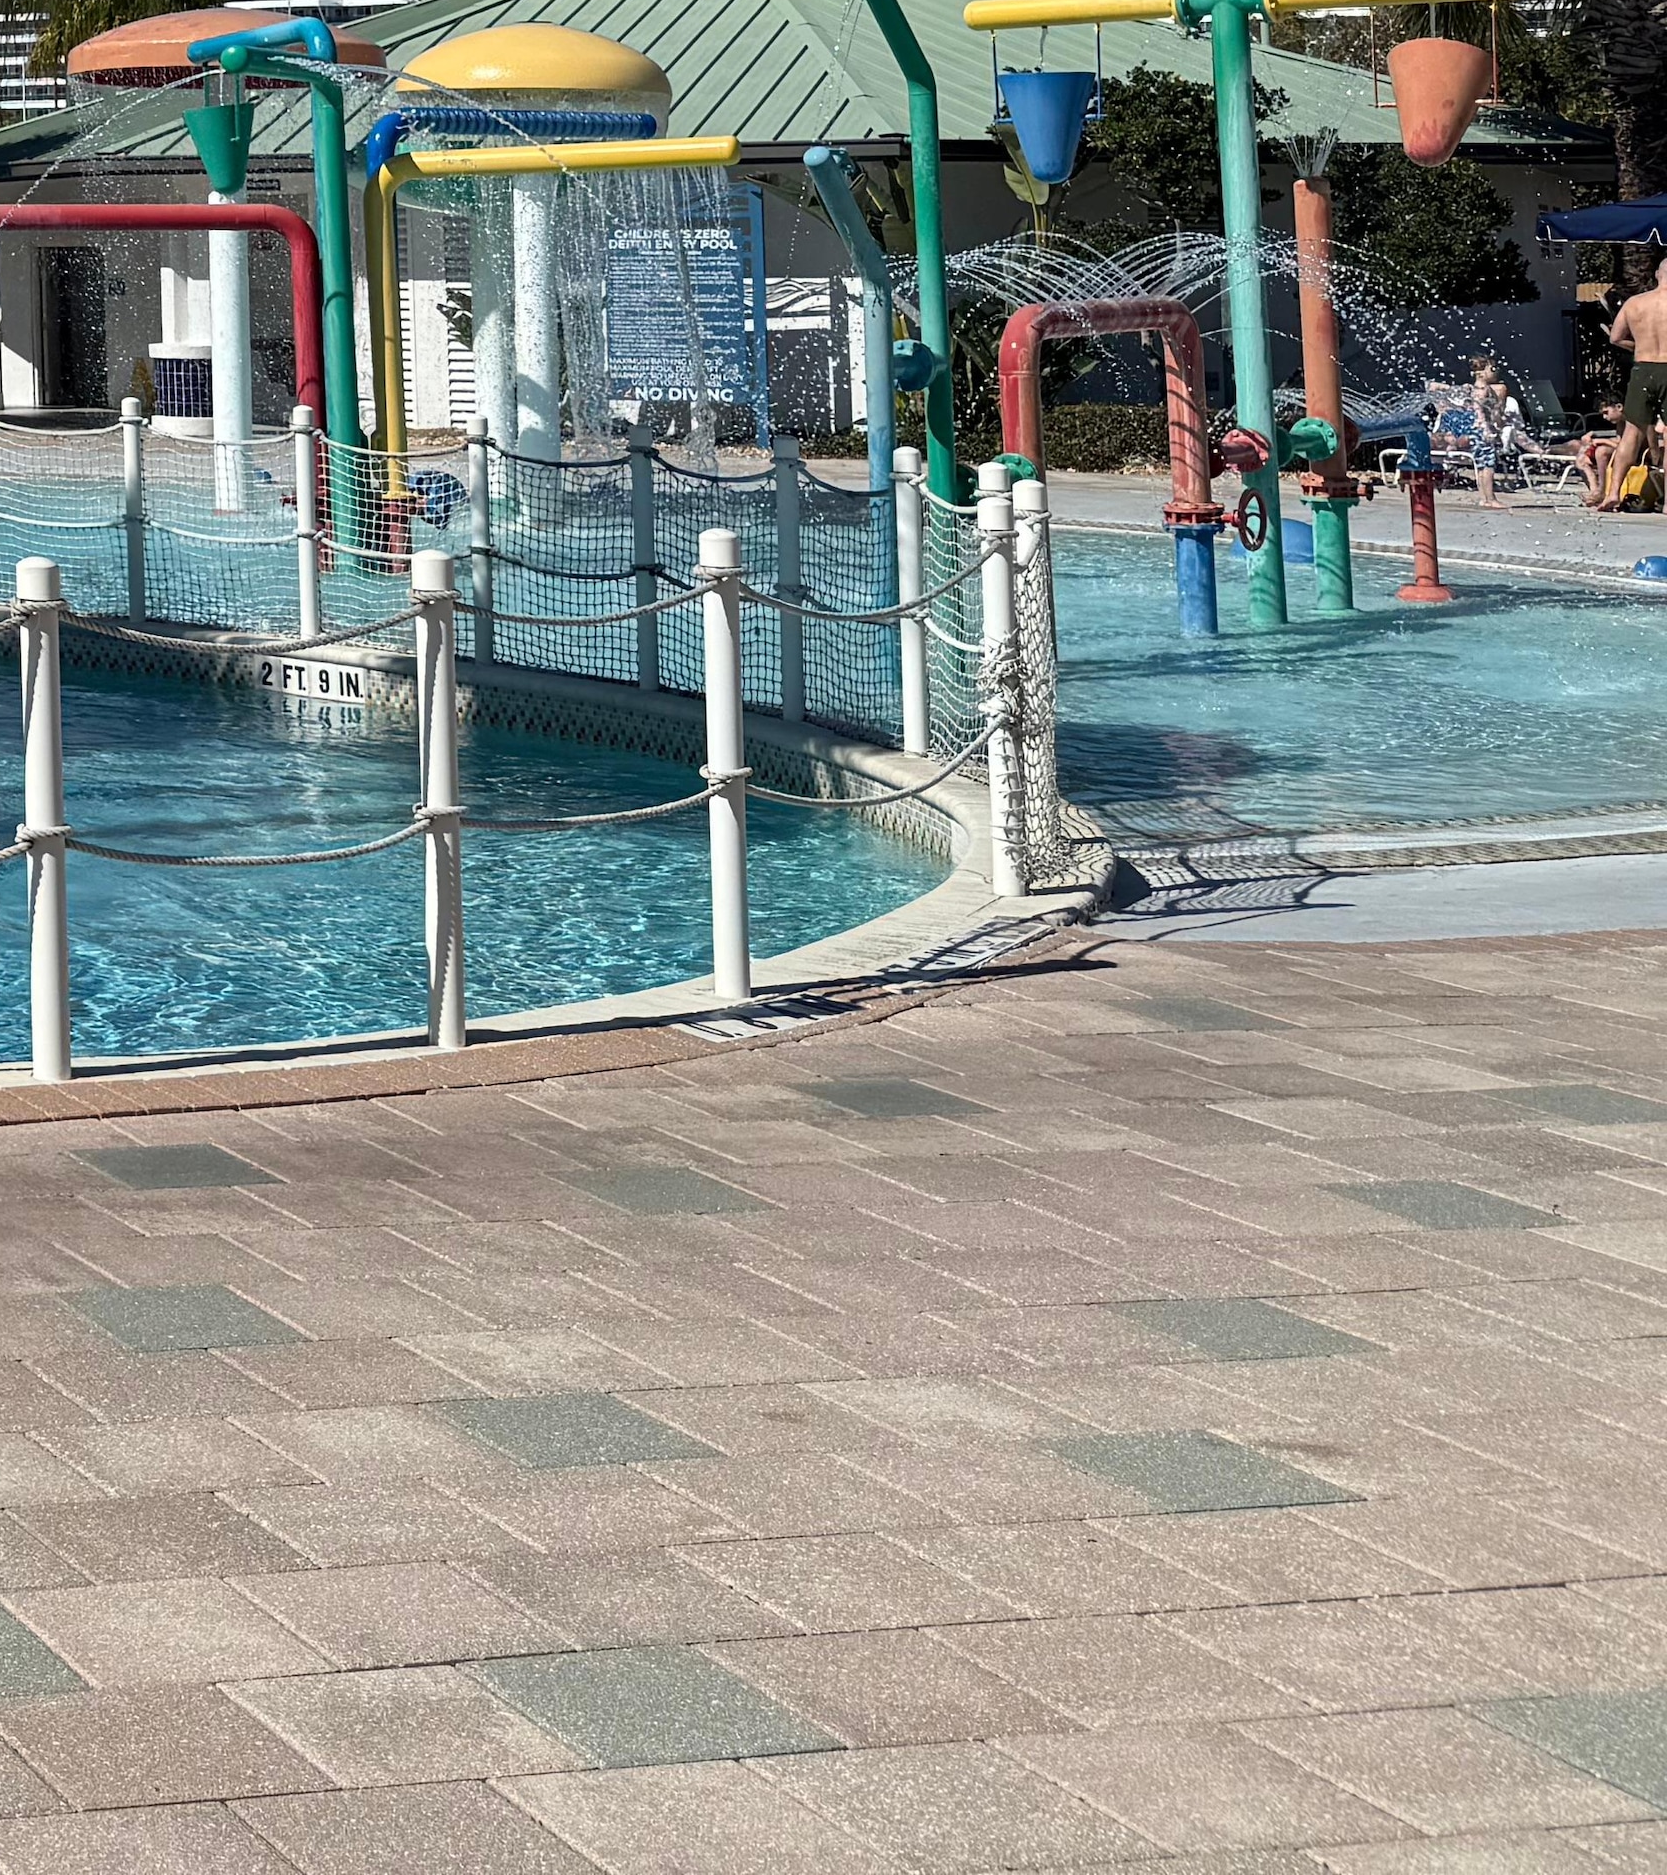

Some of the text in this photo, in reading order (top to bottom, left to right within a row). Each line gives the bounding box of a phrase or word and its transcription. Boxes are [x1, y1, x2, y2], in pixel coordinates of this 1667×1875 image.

[694, 229, 730, 239] ZERO
[700, 240, 738, 250] POOL
[635, 386, 734, 402] NO DIVNG
[261, 661, 365, 699] 2 FT. 9 IN.
